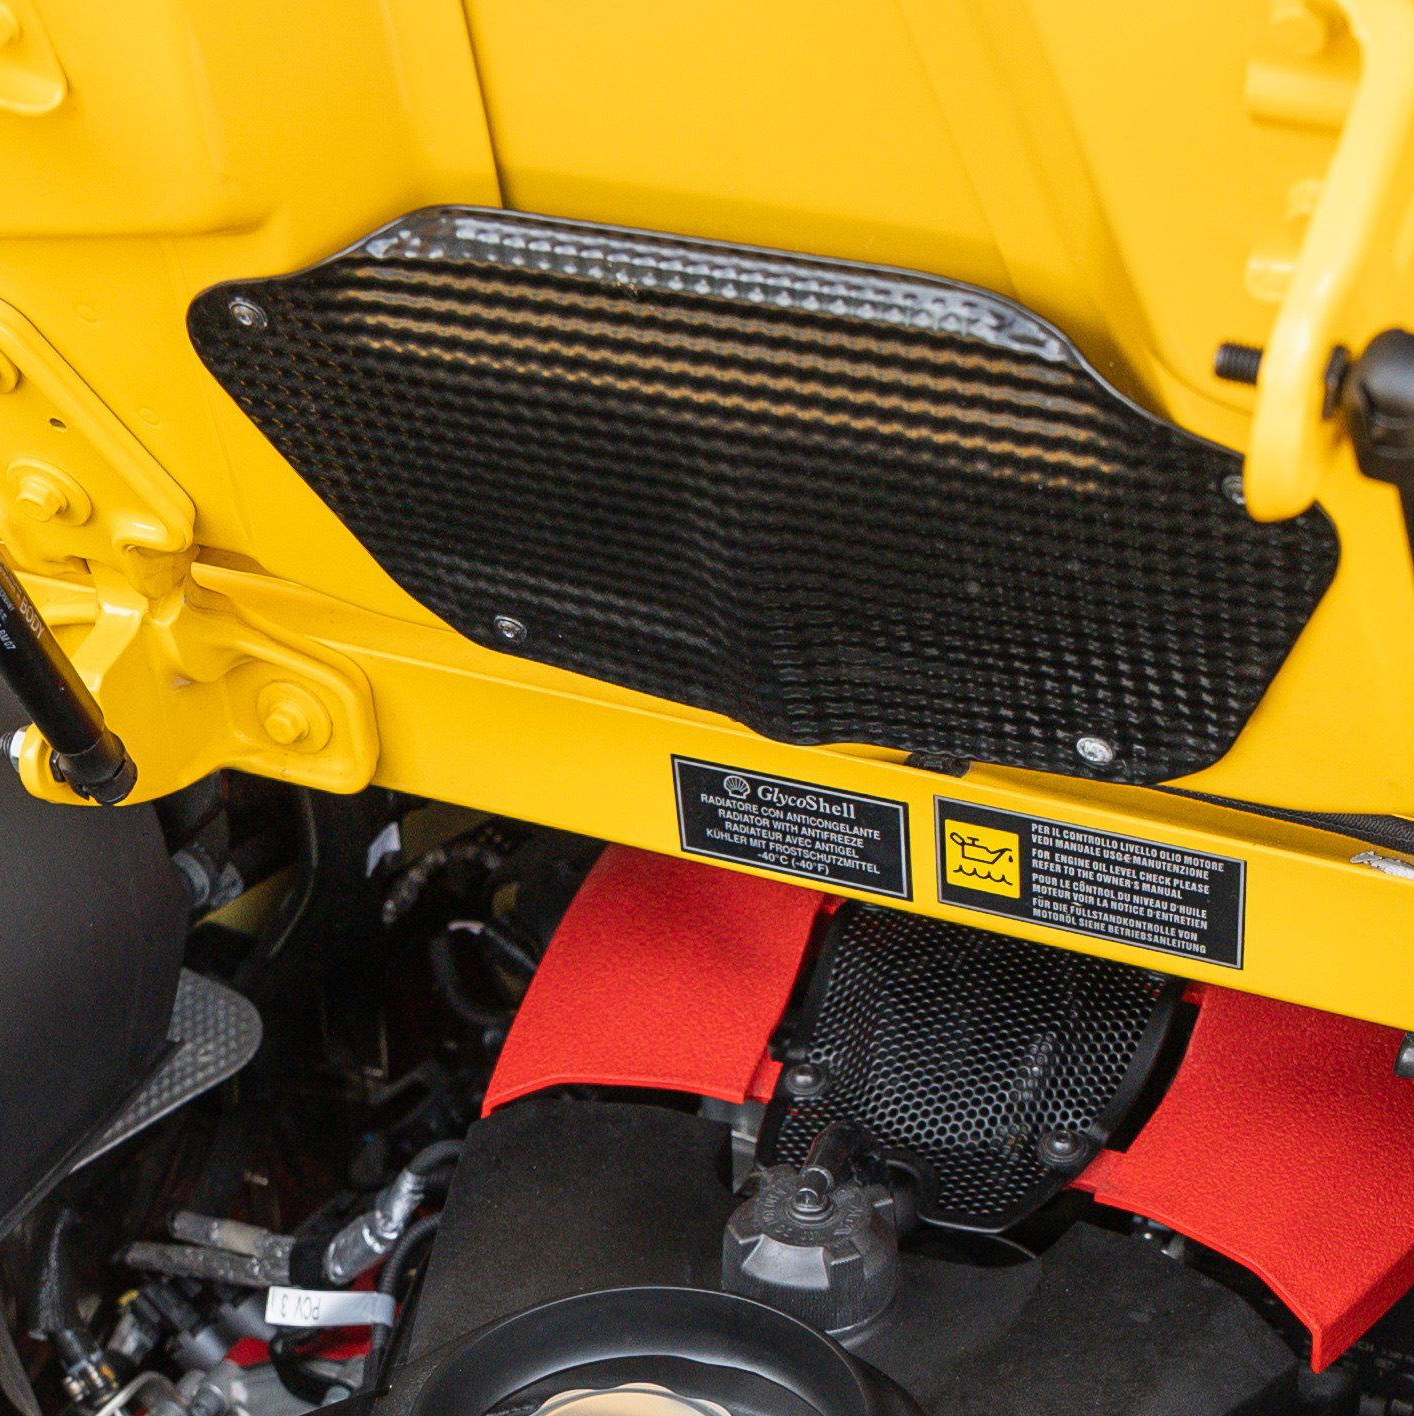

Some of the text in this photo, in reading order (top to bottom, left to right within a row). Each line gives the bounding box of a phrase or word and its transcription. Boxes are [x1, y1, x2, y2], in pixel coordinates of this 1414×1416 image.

[19, 598, 45, 639] BODY
[701, 794, 880, 840] RADIATORE CON ANTICONGELANTE
[757, 785, 855, 819] GlycoShell
[706, 828, 880, 874] KÜHLER MIT FROSTSCHUTZMITTEL
[718, 809, 864, 848] RADIATOR WITH ANTIFREEZE
[725, 822, 858, 858] RADIATEUR AVEC ANTIGEL
[1032, 824, 1224, 872] PER IL CONTROLLO LIVELLO OLIO MOTORE
[1032, 834, 1053, 846] VEDI
[1055, 838, 1101, 856] MANUALE
[1133, 857, 1209, 880] MANUTENZIONE
[1032, 849, 1209, 894] FOR ENGINE OIL LEVEL CHECK PLEASE
[1032, 859, 1182, 899] REFER TO THE OWNER'S MANUAL
[1032, 873, 1058, 886] POUR
[1060, 878, 1070, 888] LE
[1118, 891, 1131, 901] DU
[1133, 895, 1168, 911] NIVEAU
[1170, 902, 1207, 918] D'HUILE
[1033, 884, 1208, 930] MOTEUR VOIR LA NOTICE D'ENTRETIEN
[1033, 896, 1051, 909] FÜR
[1053, 902, 1067, 913] DIE
[1178, 929, 1197, 941] VON
[1079, 918, 1106, 932] SIEHE
[1108, 924, 1206, 954] BETRIEBSANLEITUNG
[282, 1294, 321, 1320] PCV 3
